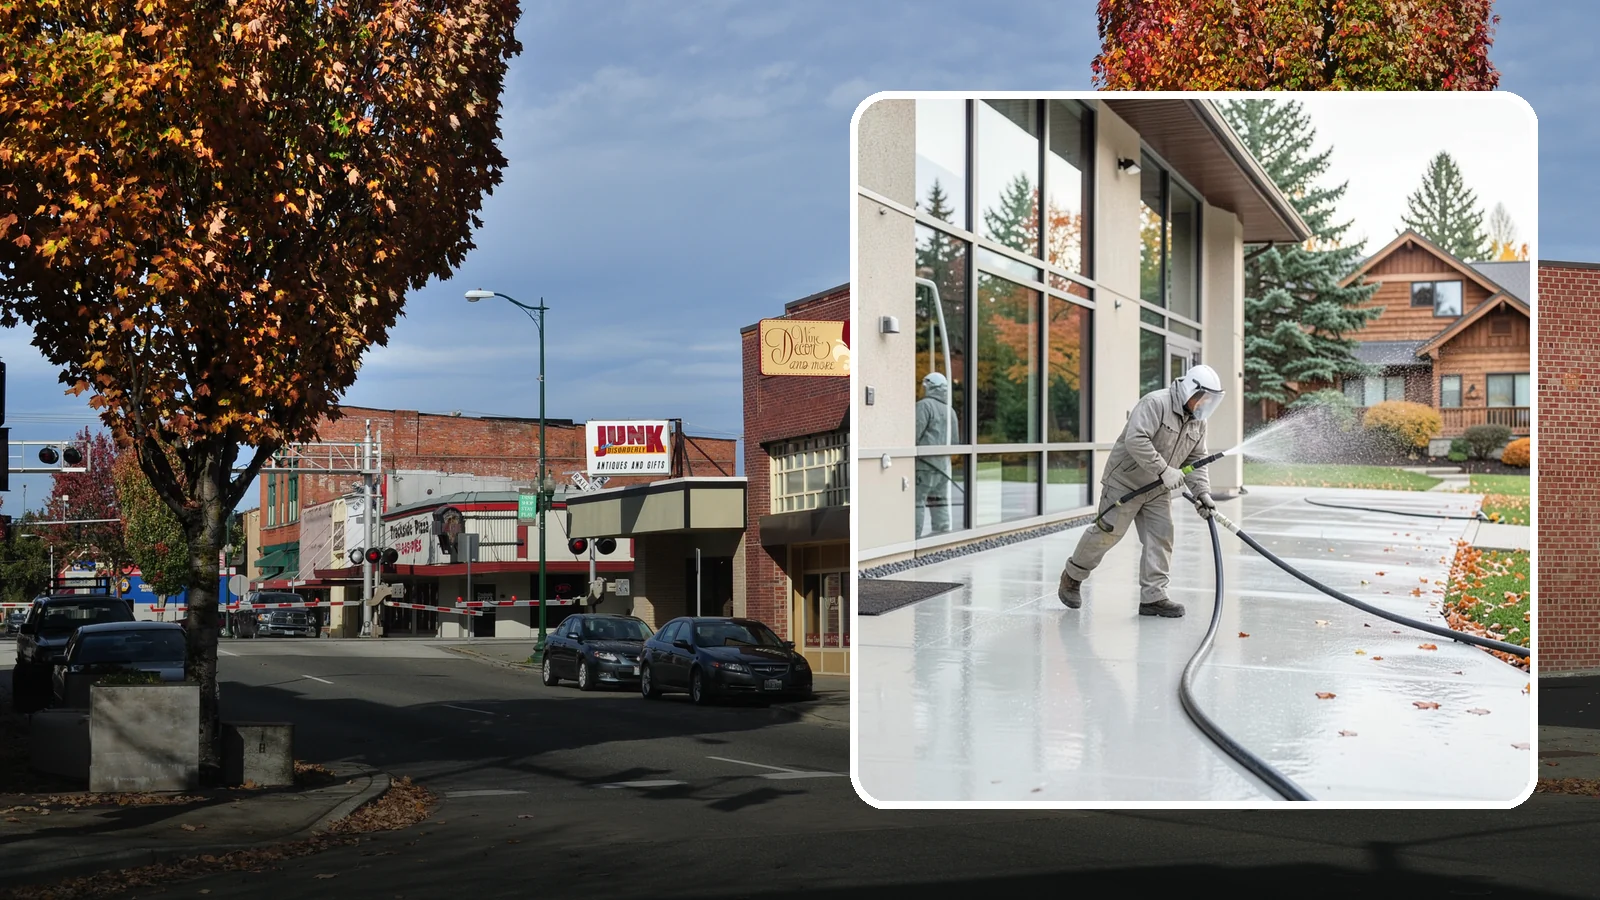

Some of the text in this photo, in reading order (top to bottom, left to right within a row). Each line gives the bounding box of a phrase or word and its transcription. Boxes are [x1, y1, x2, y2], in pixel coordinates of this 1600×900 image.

[596, 425, 665, 457] JUNK
[607, 446, 646, 454] DISORDERLY
[597, 460, 665, 470] ANTIQUES AND GIFTS
[573, 473, 589, 490] RAIL
[414, 519, 429, 535] Pizza
